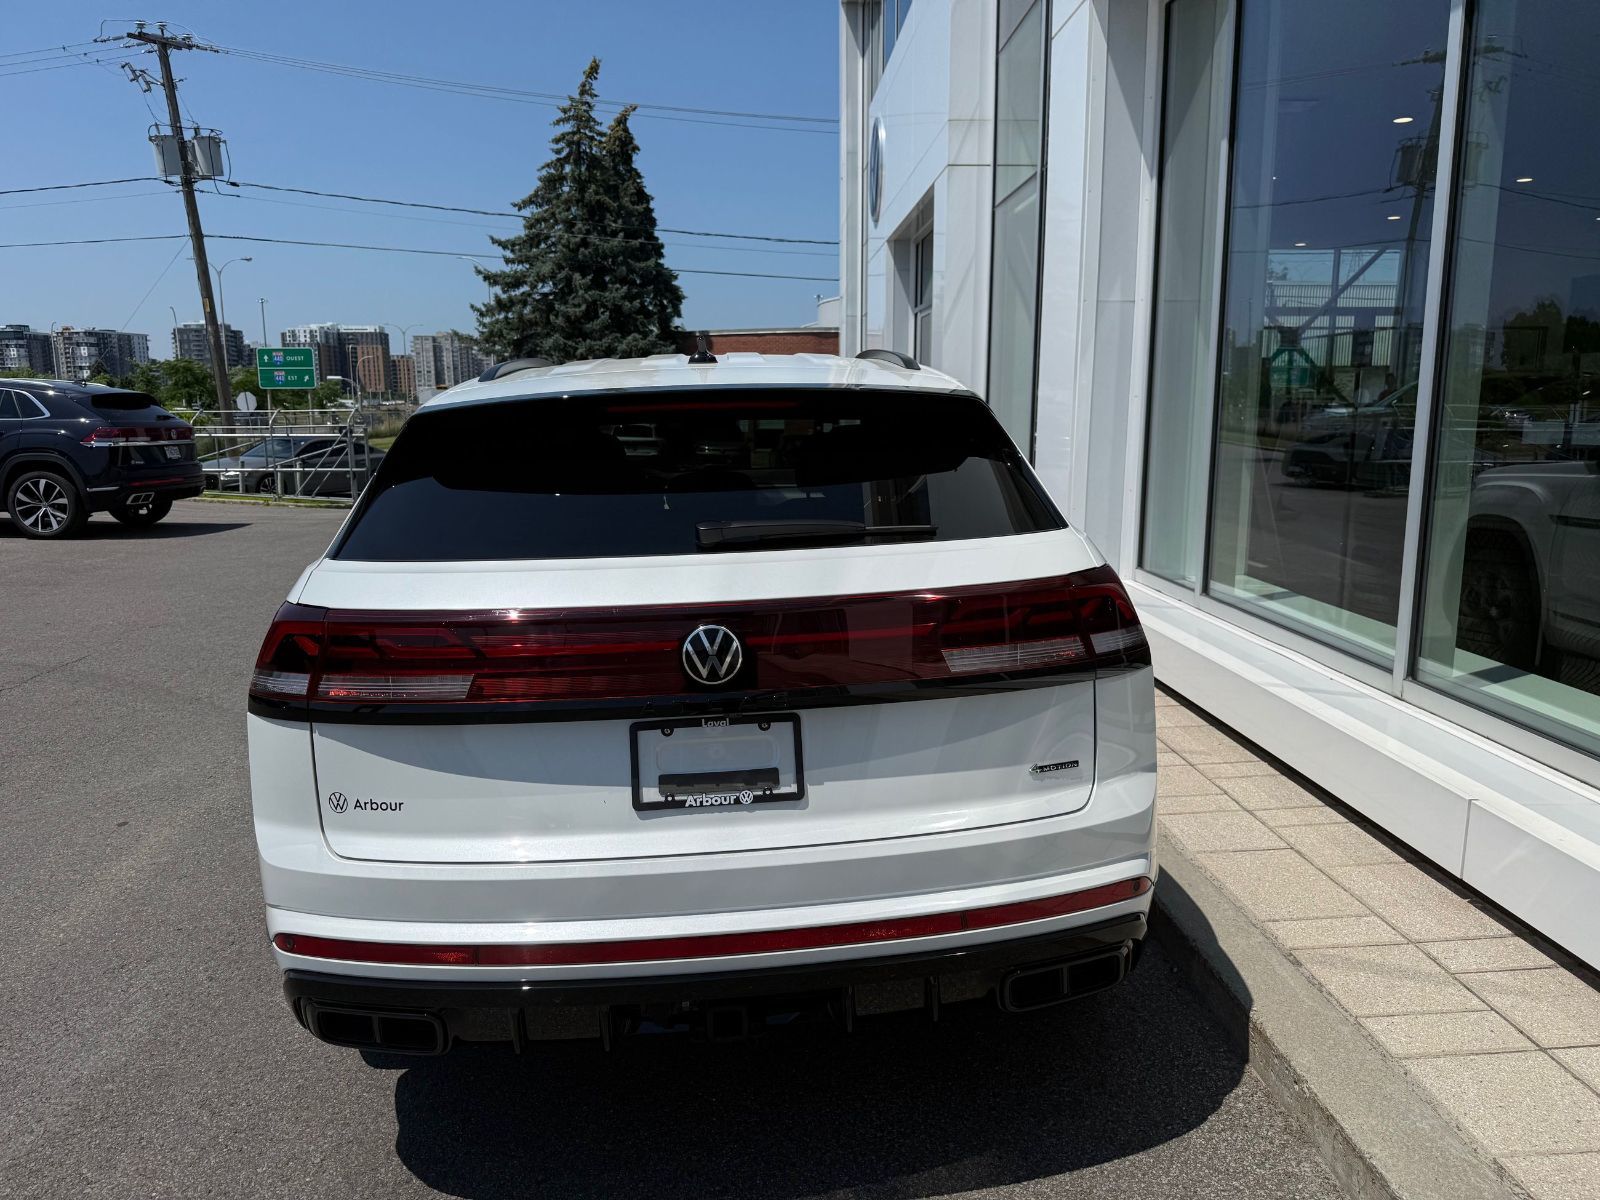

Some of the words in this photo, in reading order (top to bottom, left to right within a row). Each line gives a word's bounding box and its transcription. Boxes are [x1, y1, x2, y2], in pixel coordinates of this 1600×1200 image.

[701, 718, 730, 728] Laval
[353, 798, 404, 812] Arbour
[685, 793, 738, 808] Arbour
